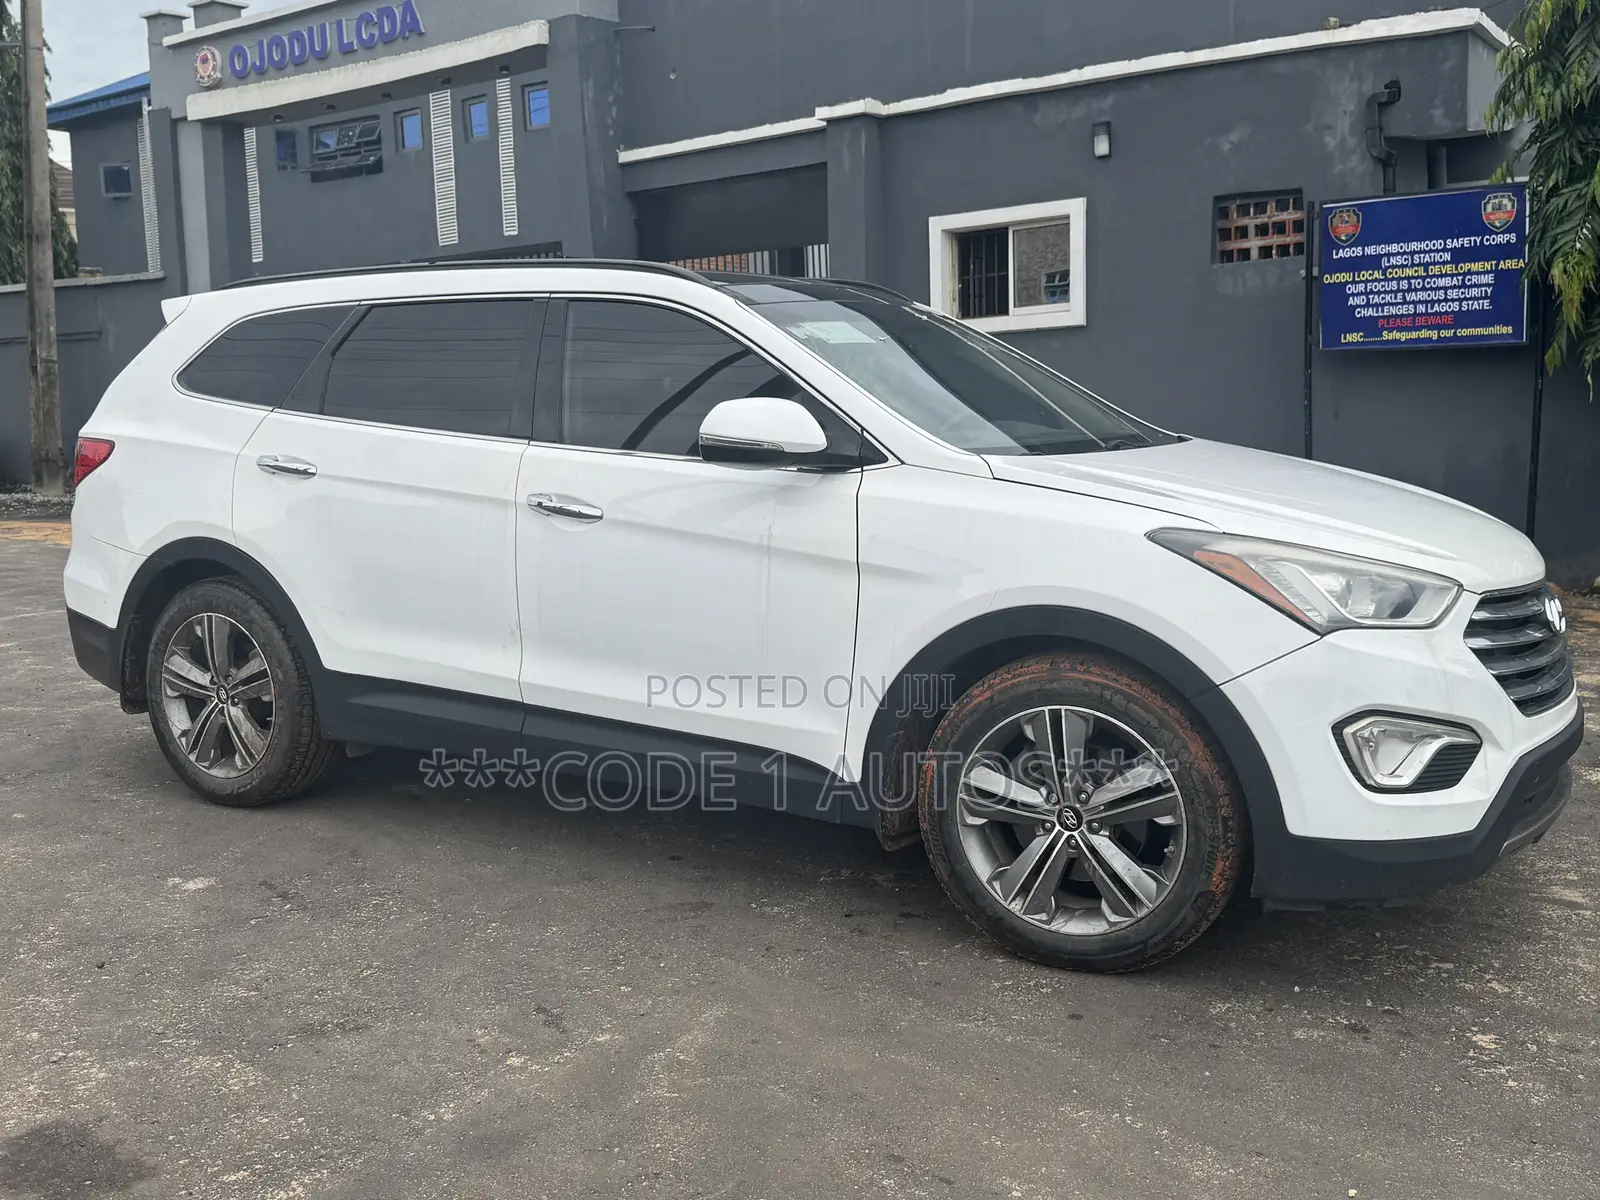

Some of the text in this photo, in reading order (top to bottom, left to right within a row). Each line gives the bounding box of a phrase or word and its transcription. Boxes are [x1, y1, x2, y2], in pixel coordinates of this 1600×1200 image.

[229, 22, 331, 79] OJODU
[337, 0, 425, 54] LCDA
[1333, 233, 1516, 259] LAGOS NEIGHBOURHOOD SAFETY CORPS
[1382, 252, 1451, 268] (LNSC) STATION
[1324, 260, 1525, 283] OJODU LOCAL COUNCIL DEVELOPMENT AREA
[1346, 274, 1495, 293] OUR FOCUS IS TO COMBAT CRIME
[1348, 287, 1492, 305] AND TACKLE VARIOUS SECURITY
[1355, 300, 1492, 317] CHALLENGES IN LAGOS STATE.
[1378, 315, 1454, 328] PLEASE BEWARE
[1440, 328, 1454, 337] our
[1457, 325, 1513, 336] communities
